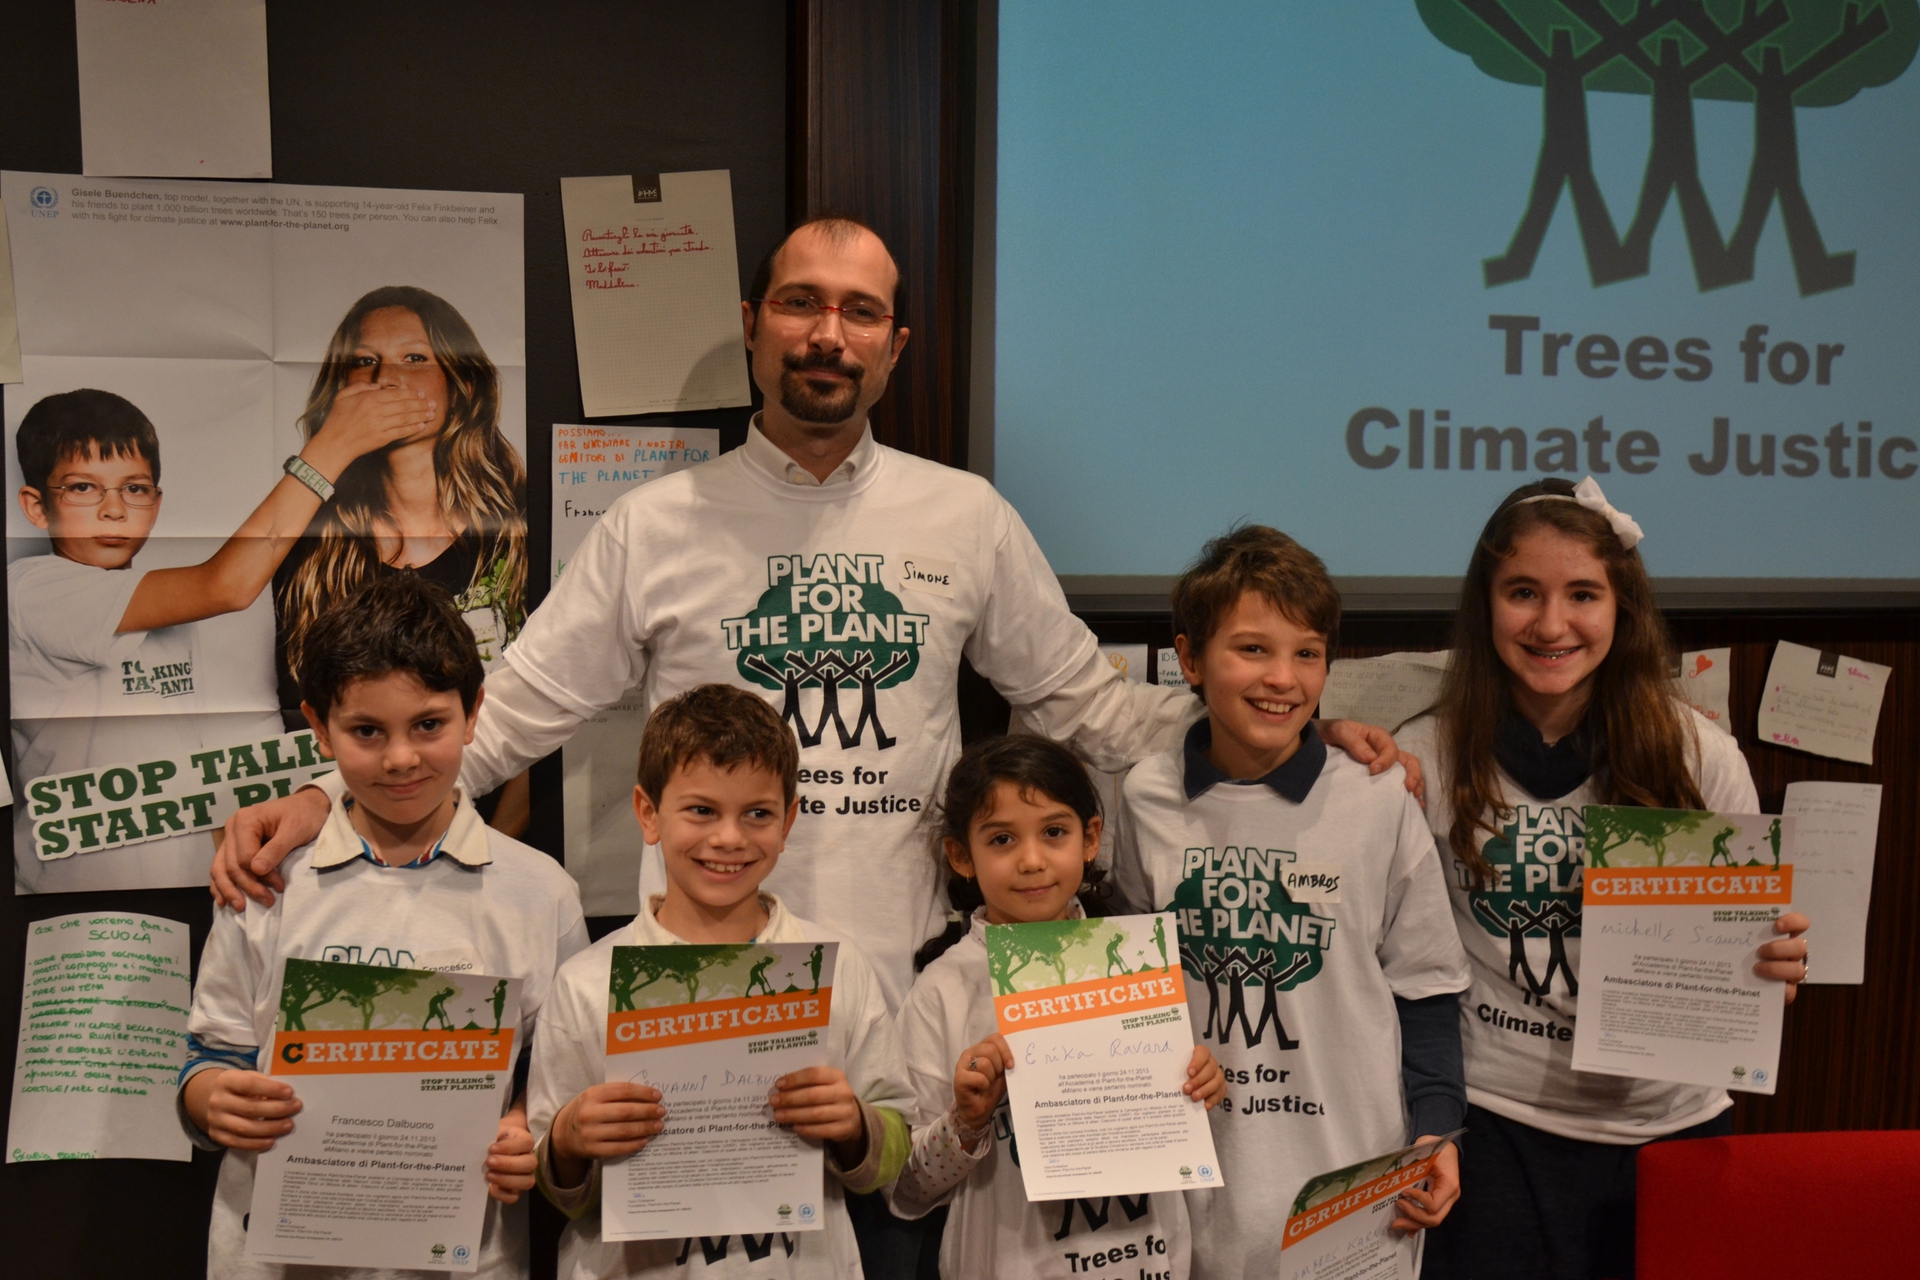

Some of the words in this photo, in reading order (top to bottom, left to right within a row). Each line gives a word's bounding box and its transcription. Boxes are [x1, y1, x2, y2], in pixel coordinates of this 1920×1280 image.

[71, 188, 102, 197] Gisele
[105, 189, 161, 201] Buendchen,
[164, 193, 178, 202] top
[213, 195, 249, 205] together
[252, 196, 269, 204] with
[270, 197, 284, 205] the
[305, 199, 312, 207] is
[314, 200, 359, 210] supporting
[362, 201, 409, 210] 14-year-old
[411, 203, 432, 211] Felix
[433, 203, 477, 213] Finkbeiner
[71, 200, 85, 208] his
[87, 201, 118, 210] friends
[120, 202, 129, 210] to
[131, 203, 153, 212] plant
[156, 203, 181, 212] 1.000
[183, 204, 209, 213] billion
[211, 206, 233, 215] trees
[236, 207, 279, 217] worldwide.
[282, 208, 308, 217] That's
[311, 210, 327, 218] 150
[329, 211, 350, 219] trees
[352, 212, 367, 221] per
[369, 213, 399, 222] person.
[403, 214, 419, 222] You
[439, 215, 456, 223] also
[458, 216, 476, 225] help
[478, 216, 498, 225] Felix
[30, 209, 59, 218] UNEP
[71, 212, 90, 220] with
[92, 212, 106, 220] his
[108, 213, 127, 223] fight
[130, 214, 142, 222] for
[144, 214, 176, 223] climate
[178, 215, 207, 225] justice
[219, 218, 350, 232] www.plant-for-the-planet.org
[1488, 314, 1713, 381] Trees
[1739, 324, 1845, 385] for
[558, 440, 576, 450] FAR
[1344, 406, 1661, 474] Climate
[1687, 416, 1920, 480] Justic
[558, 451, 606, 464] GENITORI
[615, 453, 625, 463] DI
[634, 448, 678, 463] PLANT
[683, 448, 710, 463] FOR
[558, 471, 588, 486] THE
[597, 469, 655, 482] PLANET
[768, 553, 884, 588] PLANT
[789, 582, 866, 614] FOR
[721, 614, 789, 650] THE
[800, 612, 930, 651] PLANET
[30, 759, 177, 816] STOP
[190, 732, 337, 786] TALK
[853, 766, 888, 785] for
[835, 794, 922, 815] Justice
[38, 791, 217, 856] START
[1494, 804, 1586, 836] PLAN
[1515, 834, 1586, 864] FOR
[1183, 846, 1297, 881] PLANT
[1287, 872, 1340, 893] AMBROS
[1525, 863, 1584, 893] PLA
[1590, 874, 1782, 897] CERTIFICATE
[1202, 877, 1271, 911] FOR
[88, 929, 152, 944] SCUOLA
[1176, 908, 1205, 937] HE
[1212, 908, 1336, 950] PLANET
[1603, 974, 1663, 989] Ambasciatore
[1664, 980, 1674, 989] di
[1675, 981, 1761, 998] Plant-for-the-Planet
[1002, 976, 1176, 1023] CERTIFICATE
[615, 998, 821, 1043] CERTIFICATE
[1120, 1017, 1139, 1025] STOP
[1139, 1011, 1171, 1022] TALKING
[1122, 1022, 1146, 1031] START
[1145, 1015, 1182, 1027] PLANTING
[1477, 1003, 1573, 1042] Climate
[281, 1039, 500, 1065] CERTIFICATE
[748, 1039, 769, 1048] STOP
[769, 1034, 807, 1045] TALKING
[748, 1045, 775, 1054] START
[776, 1038, 819, 1050] PLANTING
[445, 1077, 484, 1085] TALKING
[1255, 1063, 1291, 1083] for
[420, 1084, 449, 1092] START
[449, 1083, 496, 1091] PLANTING
[1034, 1096, 1092, 1109] Ambasciatore
[1093, 1096, 1102, 1104] di
[1103, 1090, 1182, 1104] Plant-for-the-Planet
[331, 1115, 384, 1128] Francesco
[386, 1118, 435, 1130] Dalbuono
[697, 1124, 706, 1134] di
[287, 1154, 357, 1169] Ambasciatore
[358, 1158, 368, 1169] di
[371, 1159, 466, 1172] Plant-for-the-Planet
[1289, 1161, 1430, 1238] CERTIFICATE
[1064, 1243, 1139, 1274] Trees
[1145, 1234, 1167, 1257] fo
